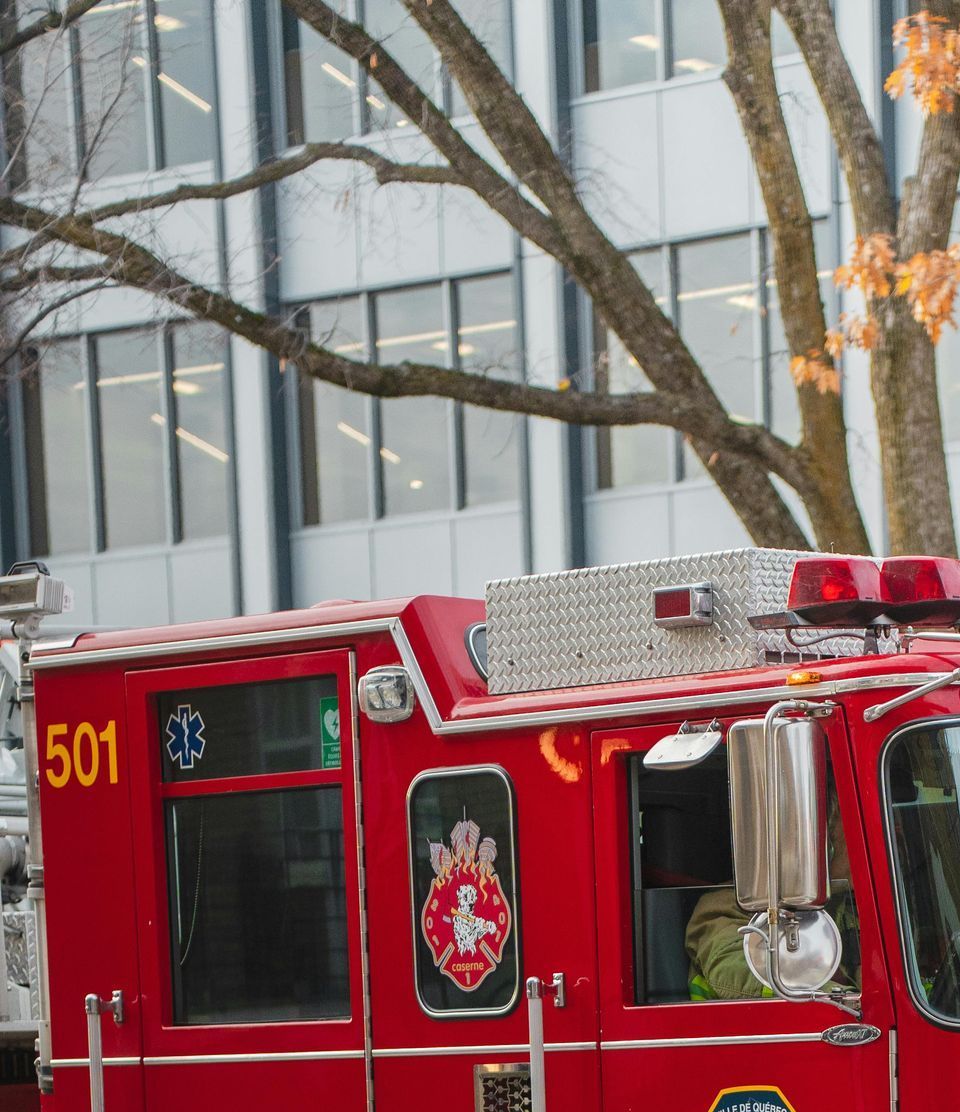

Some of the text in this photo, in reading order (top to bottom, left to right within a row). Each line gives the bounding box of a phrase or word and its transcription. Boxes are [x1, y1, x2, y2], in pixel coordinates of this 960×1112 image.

[45, 720, 119, 788] 501
[451, 961, 484, 972] caserne
[464, 972, 471, 985] 1
